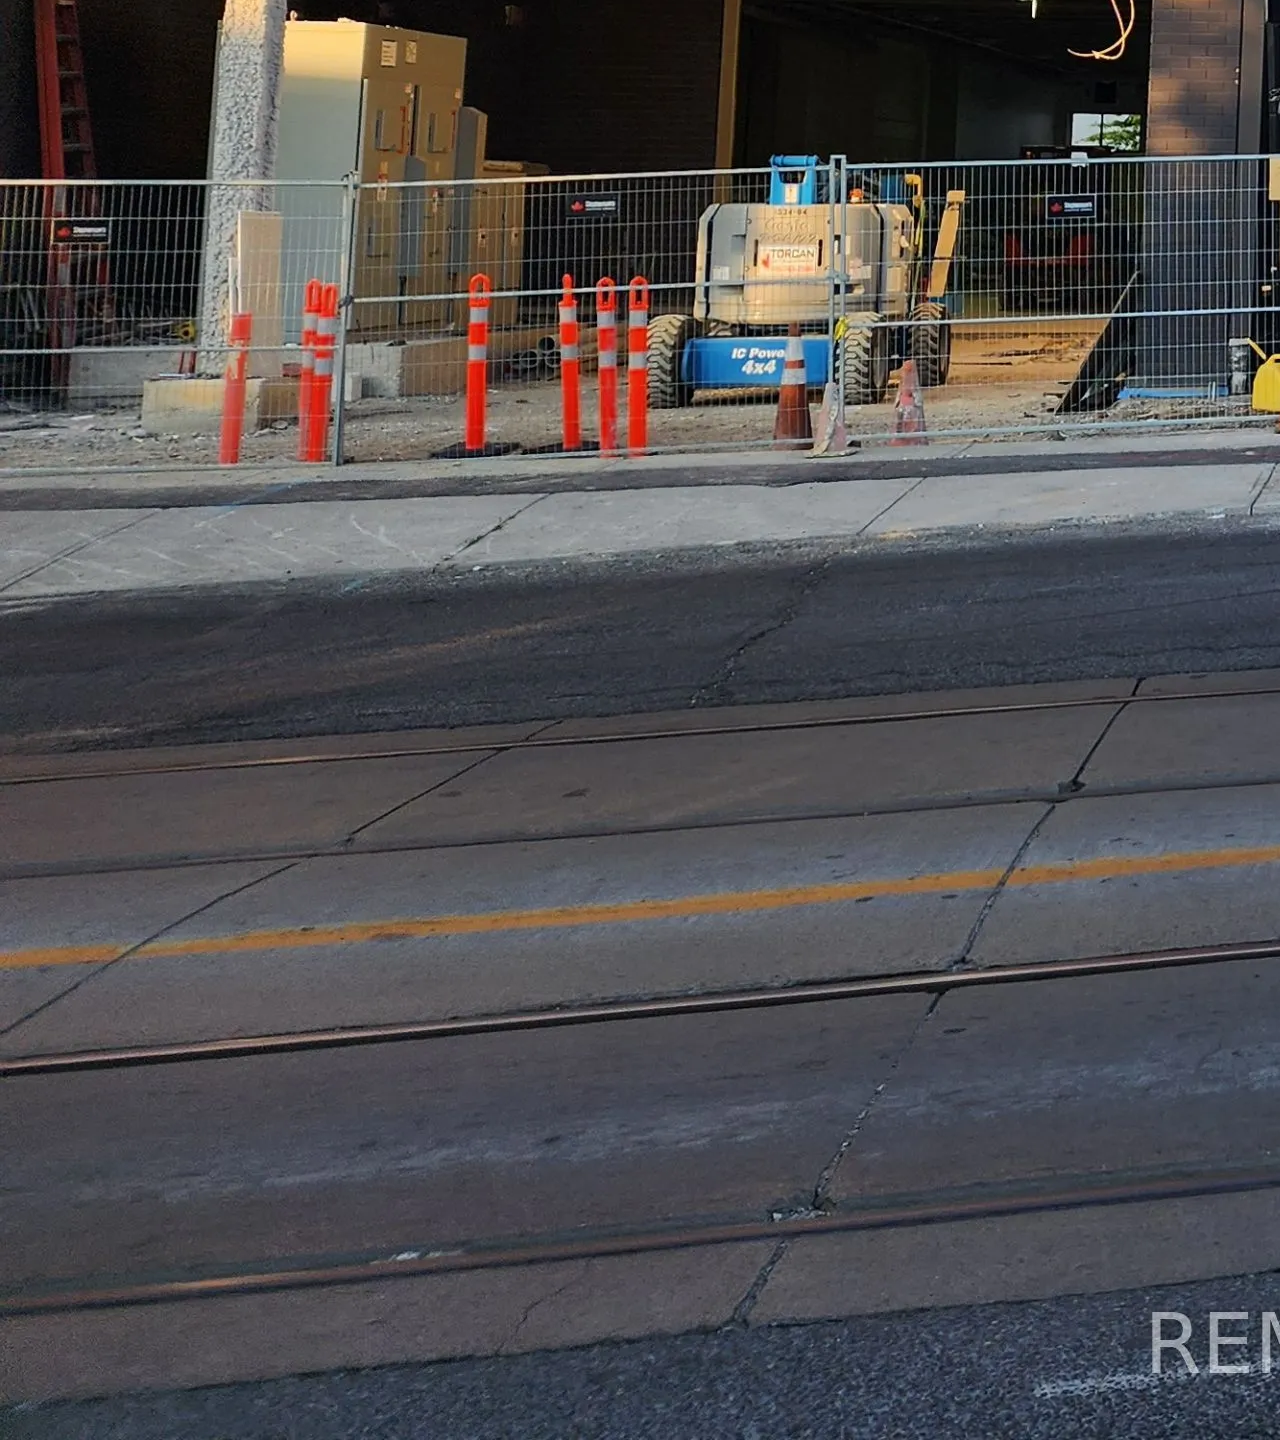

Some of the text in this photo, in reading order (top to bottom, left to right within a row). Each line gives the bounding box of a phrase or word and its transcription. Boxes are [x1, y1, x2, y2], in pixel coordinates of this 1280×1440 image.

[771, 248, 815, 259] TORCAN
[731, 347, 787, 360] IC Powe
[741, 359, 777, 375] 4x4
